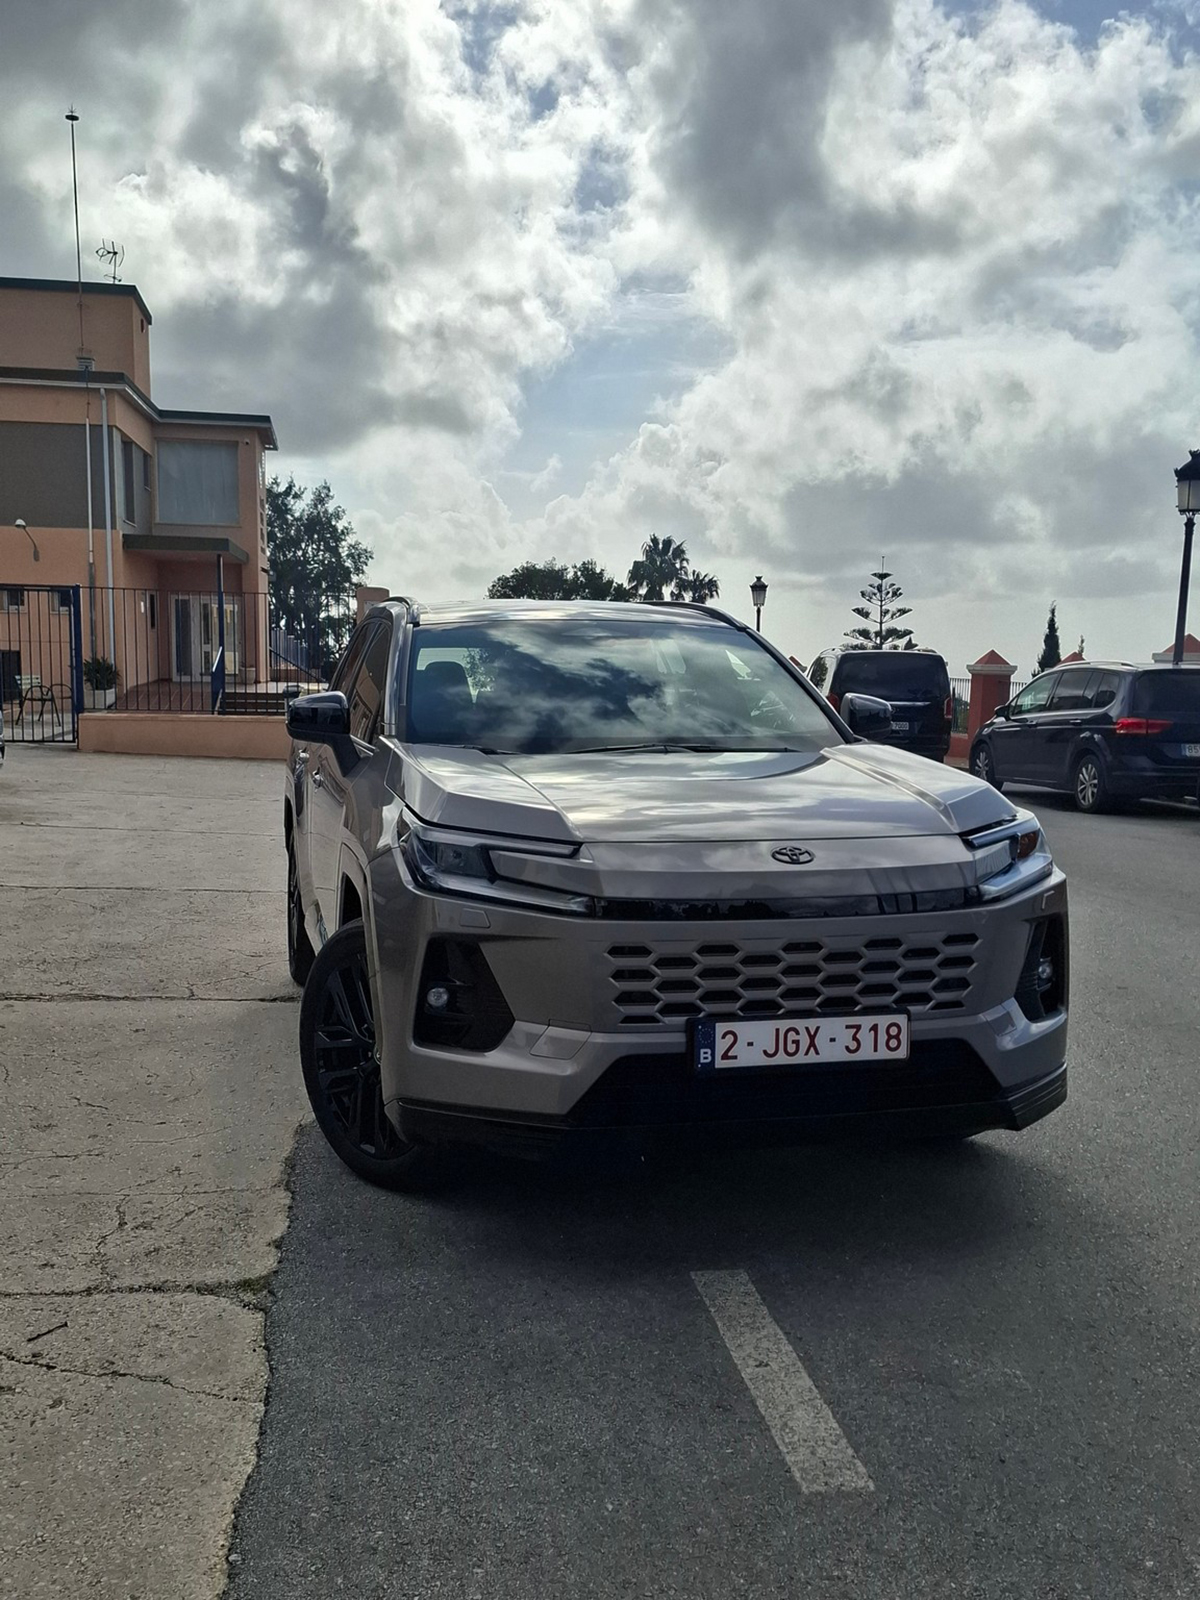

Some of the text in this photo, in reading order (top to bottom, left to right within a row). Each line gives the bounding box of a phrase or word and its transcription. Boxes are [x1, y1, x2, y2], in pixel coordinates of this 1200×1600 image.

[1187, 744, 1200, 754] 85
[700, 1021, 902, 1063] B 2-JGX-318
